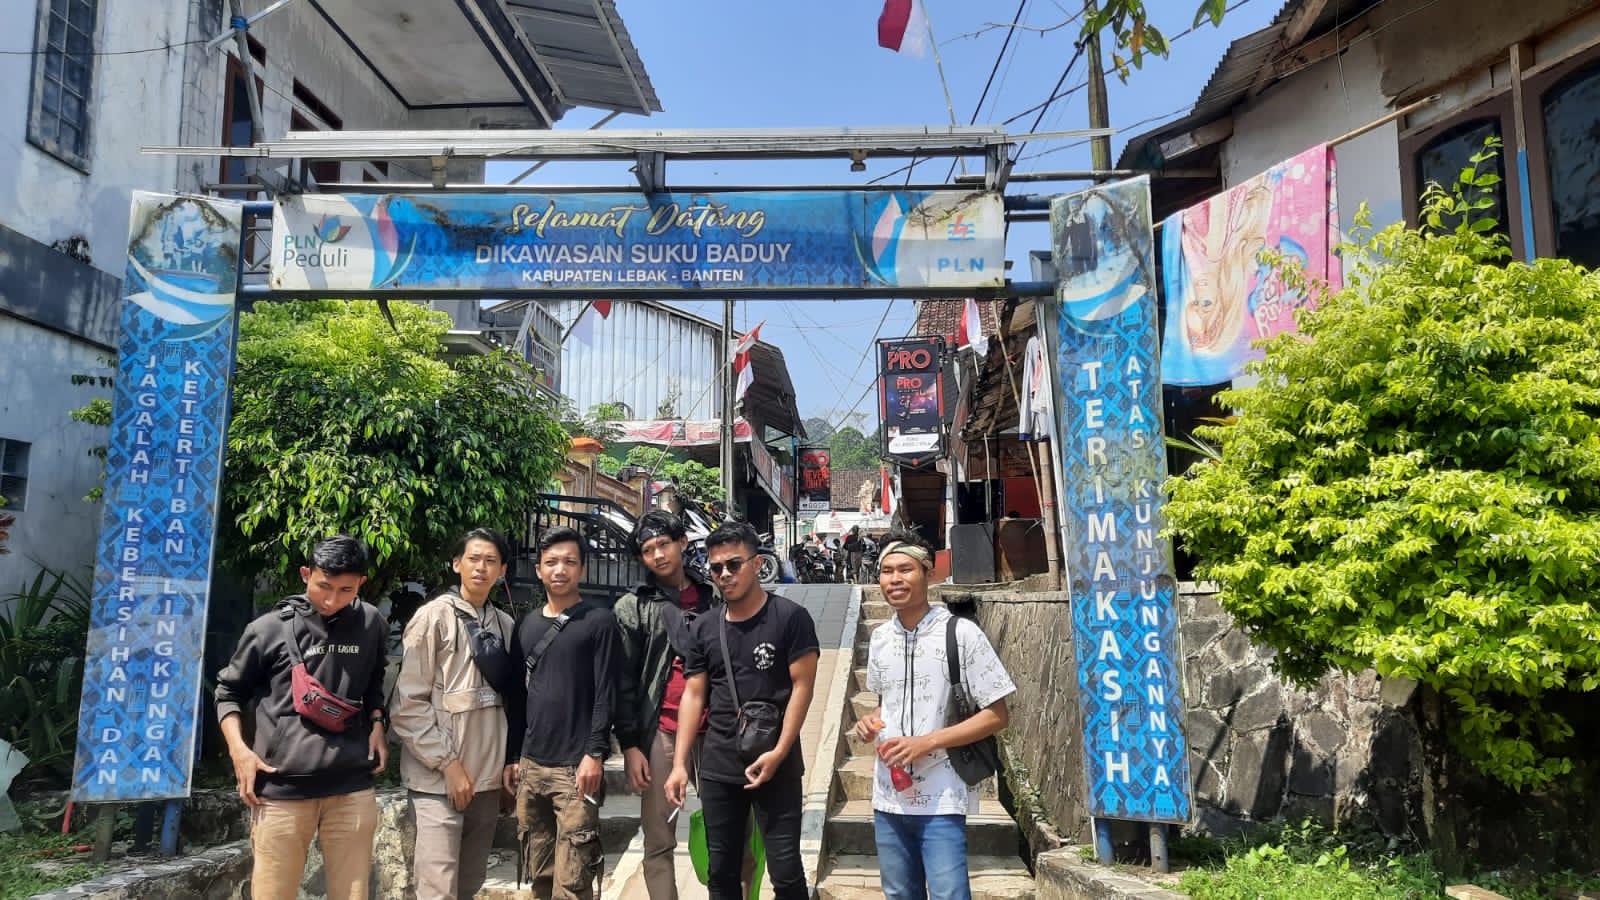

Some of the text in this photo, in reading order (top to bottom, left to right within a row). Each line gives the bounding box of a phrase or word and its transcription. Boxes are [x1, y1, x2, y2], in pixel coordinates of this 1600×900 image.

[505, 200, 765, 238] Selamat Datang
[284, 234, 316, 249] PLN
[283, 248, 348, 268] Peduli
[475, 243, 792, 264] DIKAWASAN SUKU BADUY
[937, 257, 985, 273] PLN
[522, 269, 617, 282] KABUPATEN
[617, 269, 667, 282] LEBAK
[682, 269, 744, 282] BANTEN
[888, 349, 932, 370] PRO
[896, 376, 922, 390] PRO
[802, 452, 829, 465] PRO
[98, 355, 158, 785] JAGALAH KEBERSIHAN DAN
[141, 360, 201, 783] KETERTIBAN LINGKUNGAN
[1082, 361, 1130, 784] TERIMAKASIH
[1127, 355, 1170, 786] ATAS KUNJUNGANNYA
[329, 644, 335, 653] IT
[338, 644, 360, 654] EASIER
